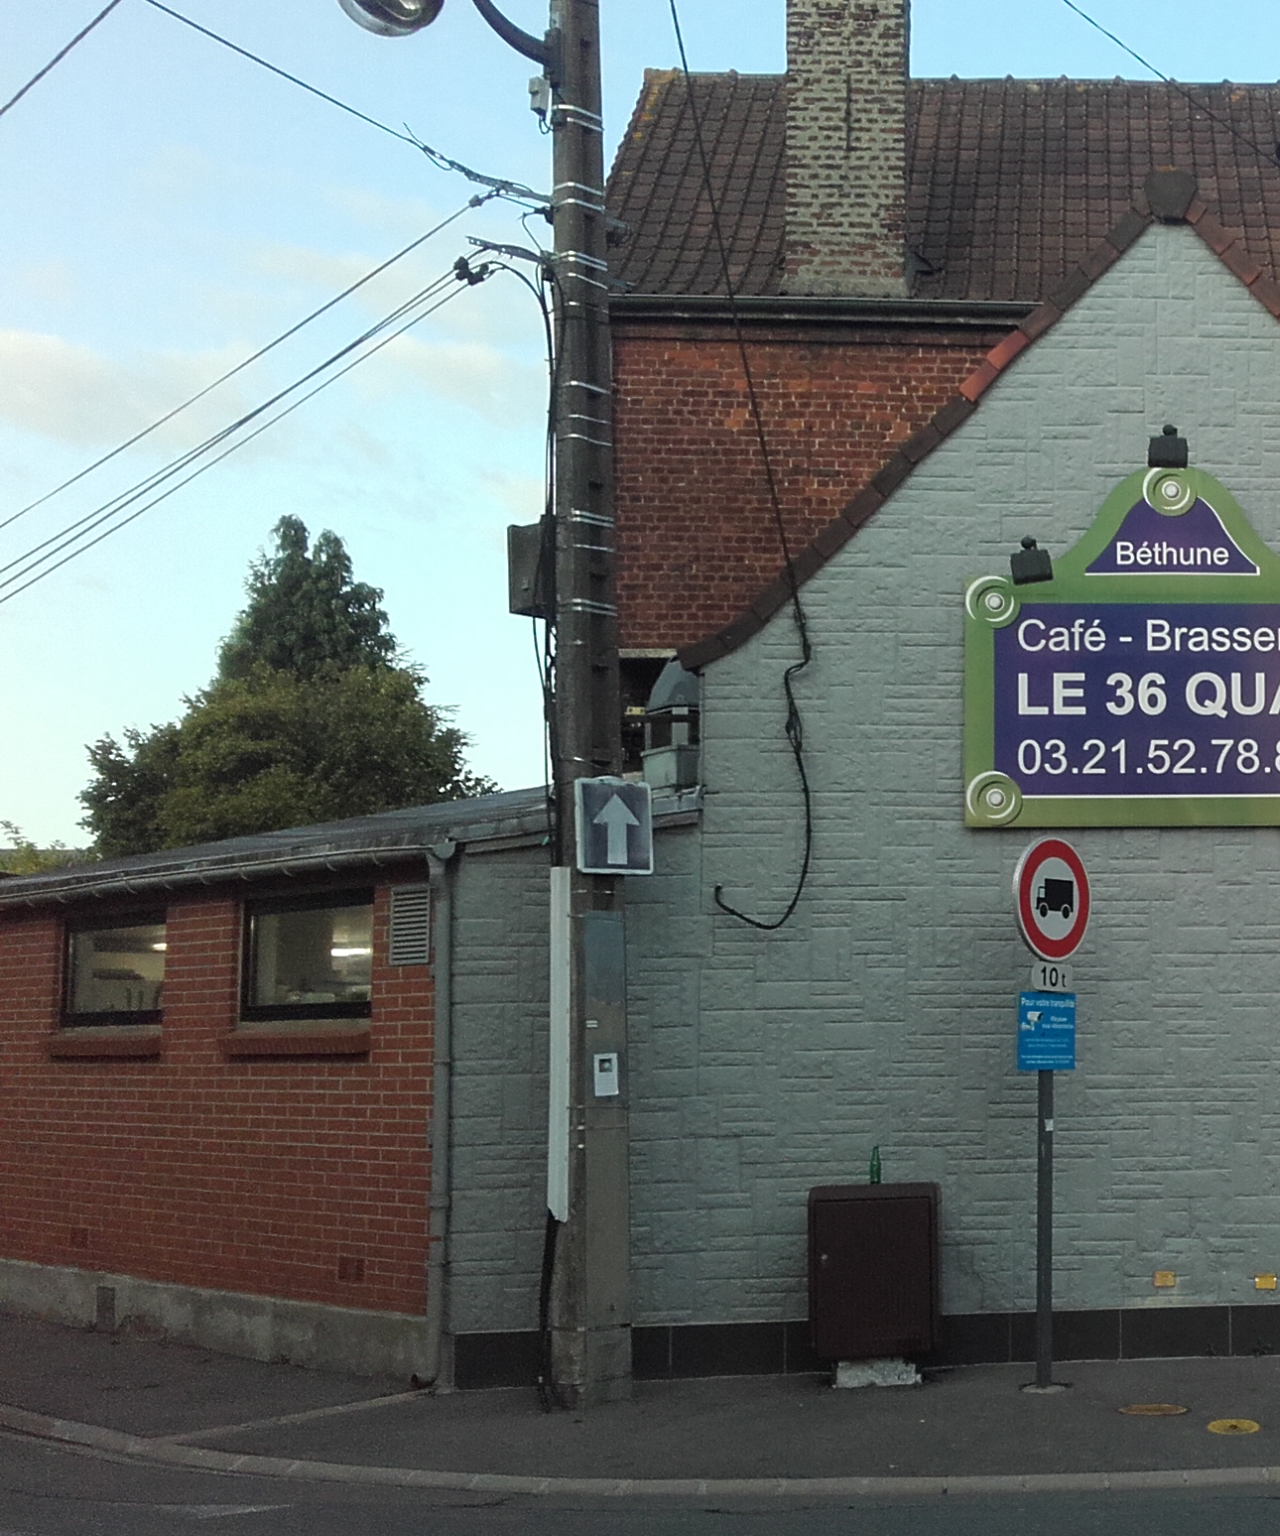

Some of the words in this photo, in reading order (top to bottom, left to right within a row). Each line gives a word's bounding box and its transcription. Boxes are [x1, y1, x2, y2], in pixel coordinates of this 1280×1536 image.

[1115, 541, 1230, 566] Béthune
[1017, 618, 1106, 652] Café
[1018, 672, 1087, 716] LE
[1105, 672, 1167, 717] 36
